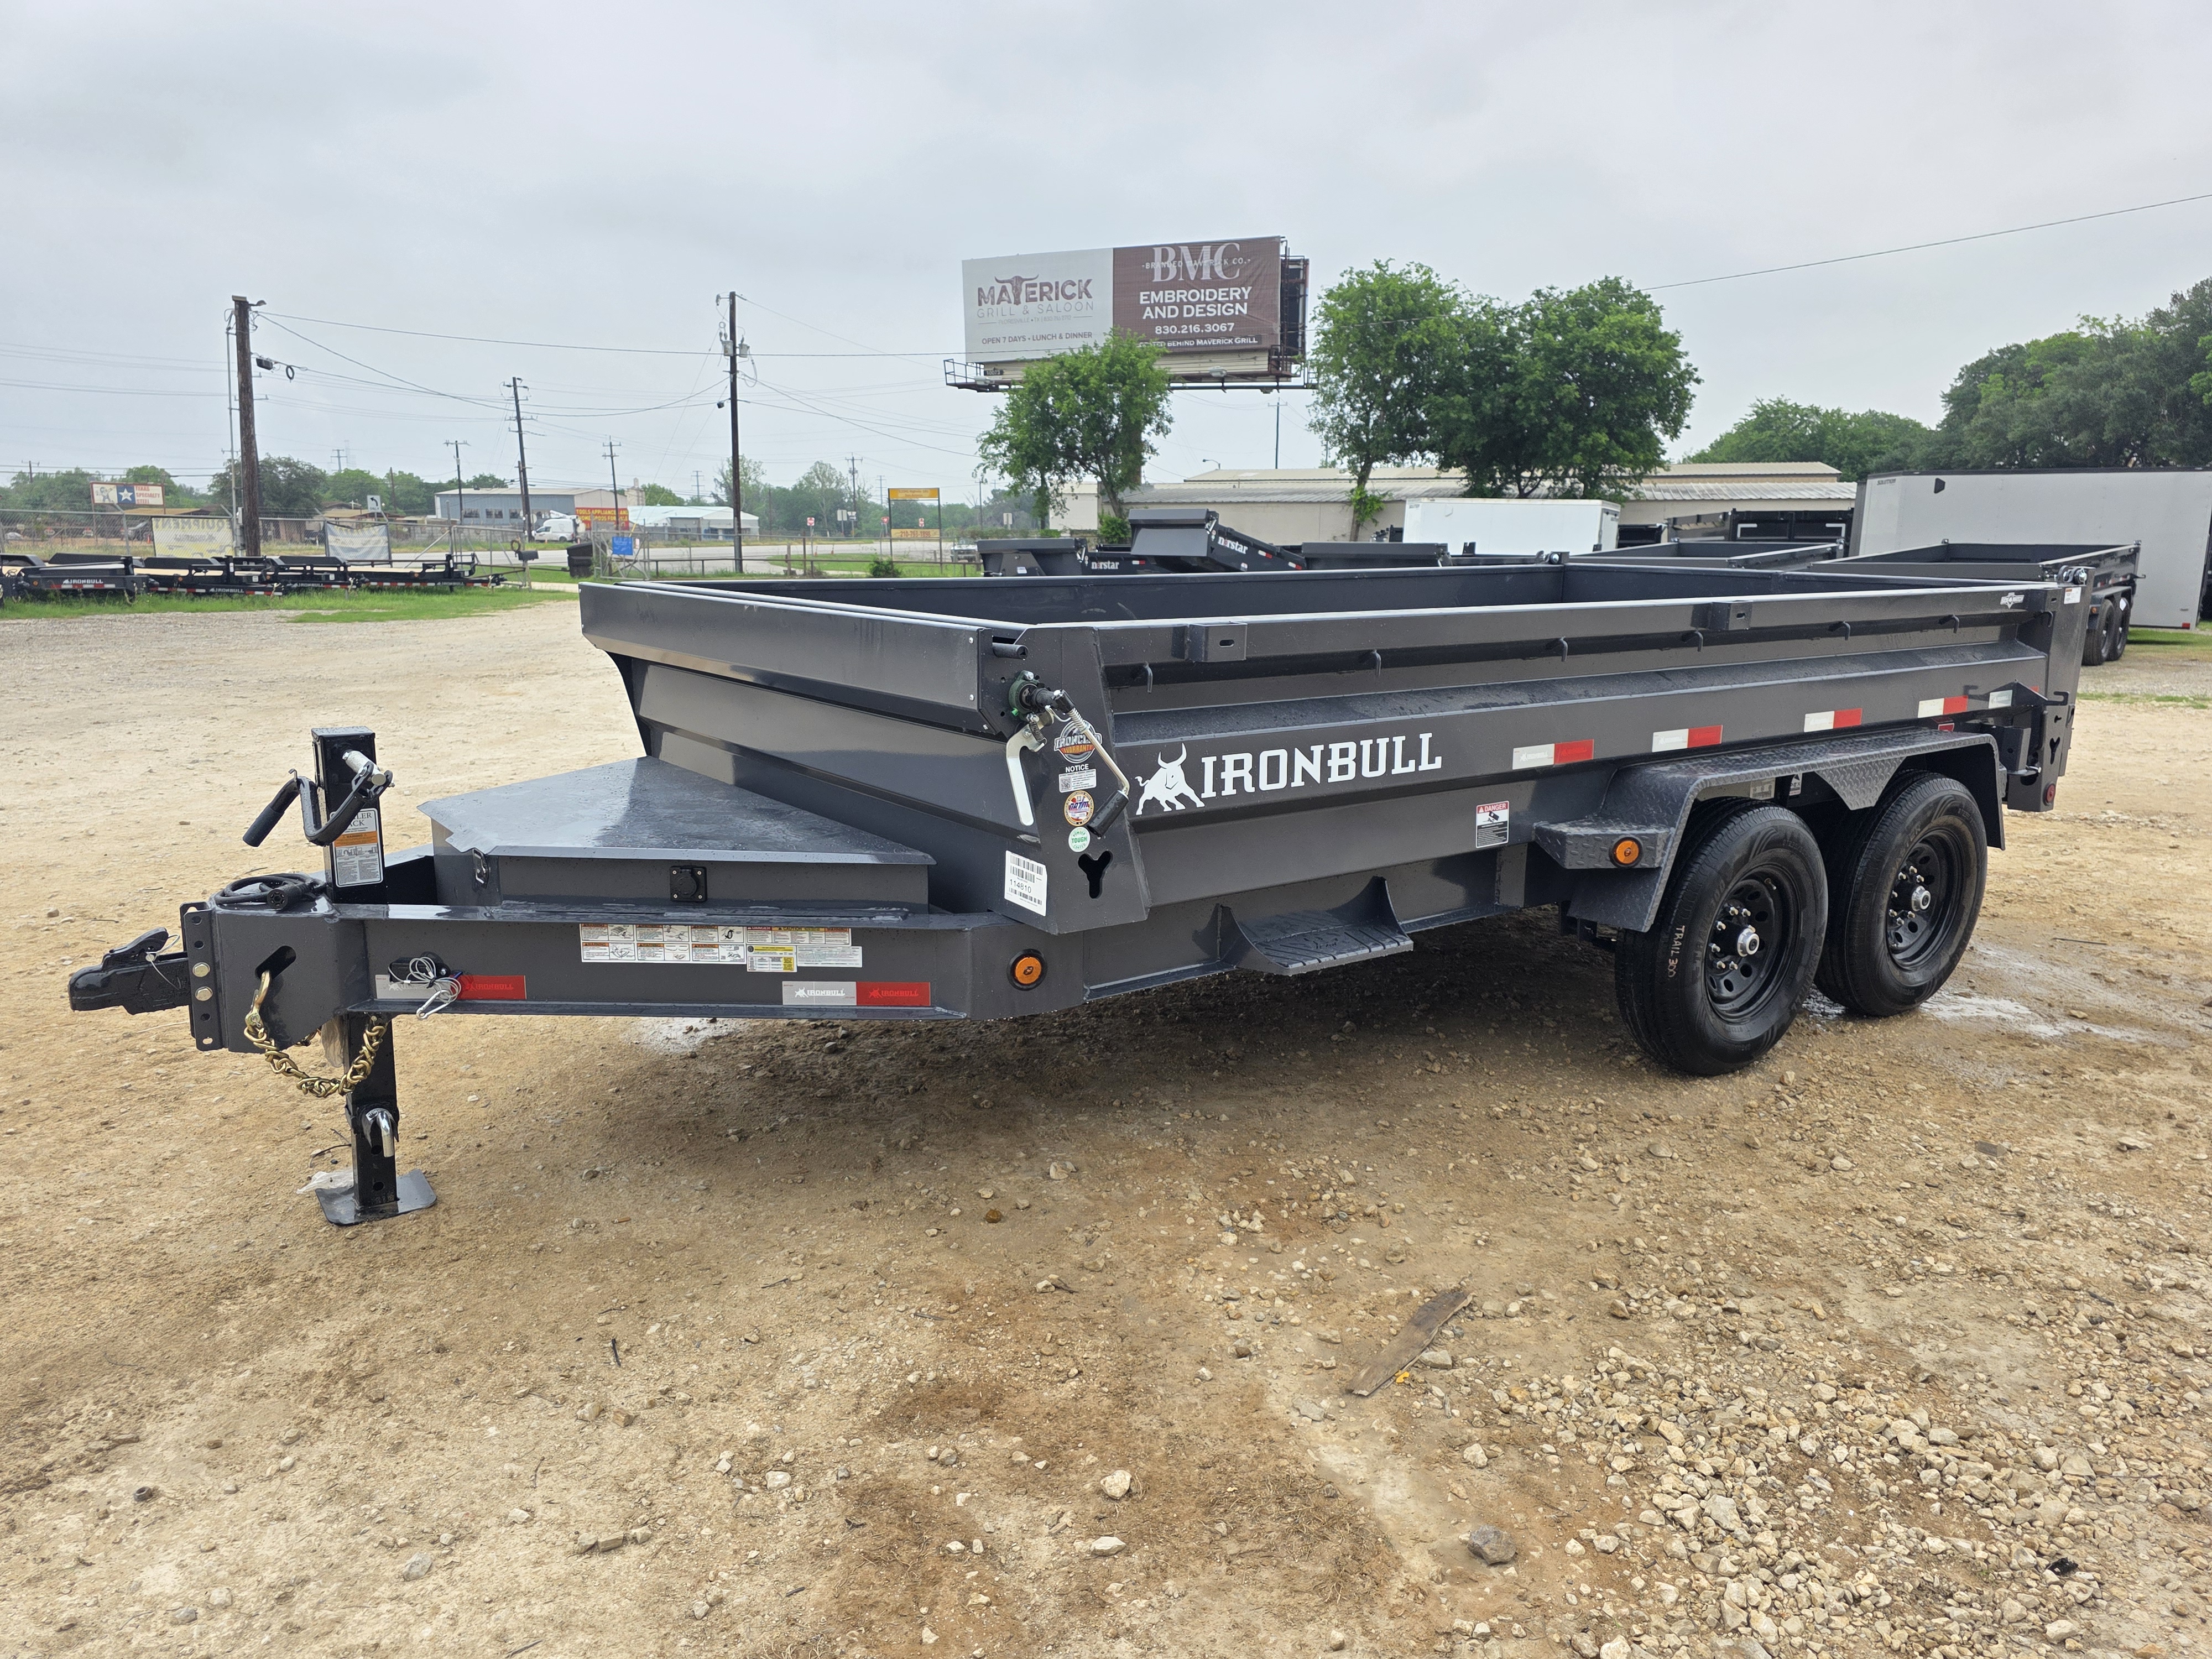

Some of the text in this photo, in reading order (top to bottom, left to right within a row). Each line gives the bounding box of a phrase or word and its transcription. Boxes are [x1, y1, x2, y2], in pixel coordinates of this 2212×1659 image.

[1152, 242, 1240, 282] BMC
[1140, 286, 1253, 304] EMBROIDERY
[977, 301, 1093, 318] GRILL & SALOON
[1142, 302, 1248, 319] AND DESIGN
[1155, 322, 1235, 335] 830.216.3067
[1218, 536, 1248, 554] norstar
[1092, 560, 1119, 569] norstar
[1063, 744, 1093, 753] WARRANTY
[1066, 764, 1089, 773] NOTICE
[1201, 732, 1442, 799] IRONBULL
[1485, 803, 1506, 812] DANGER
[1010, 879, 1032, 893] 114810
